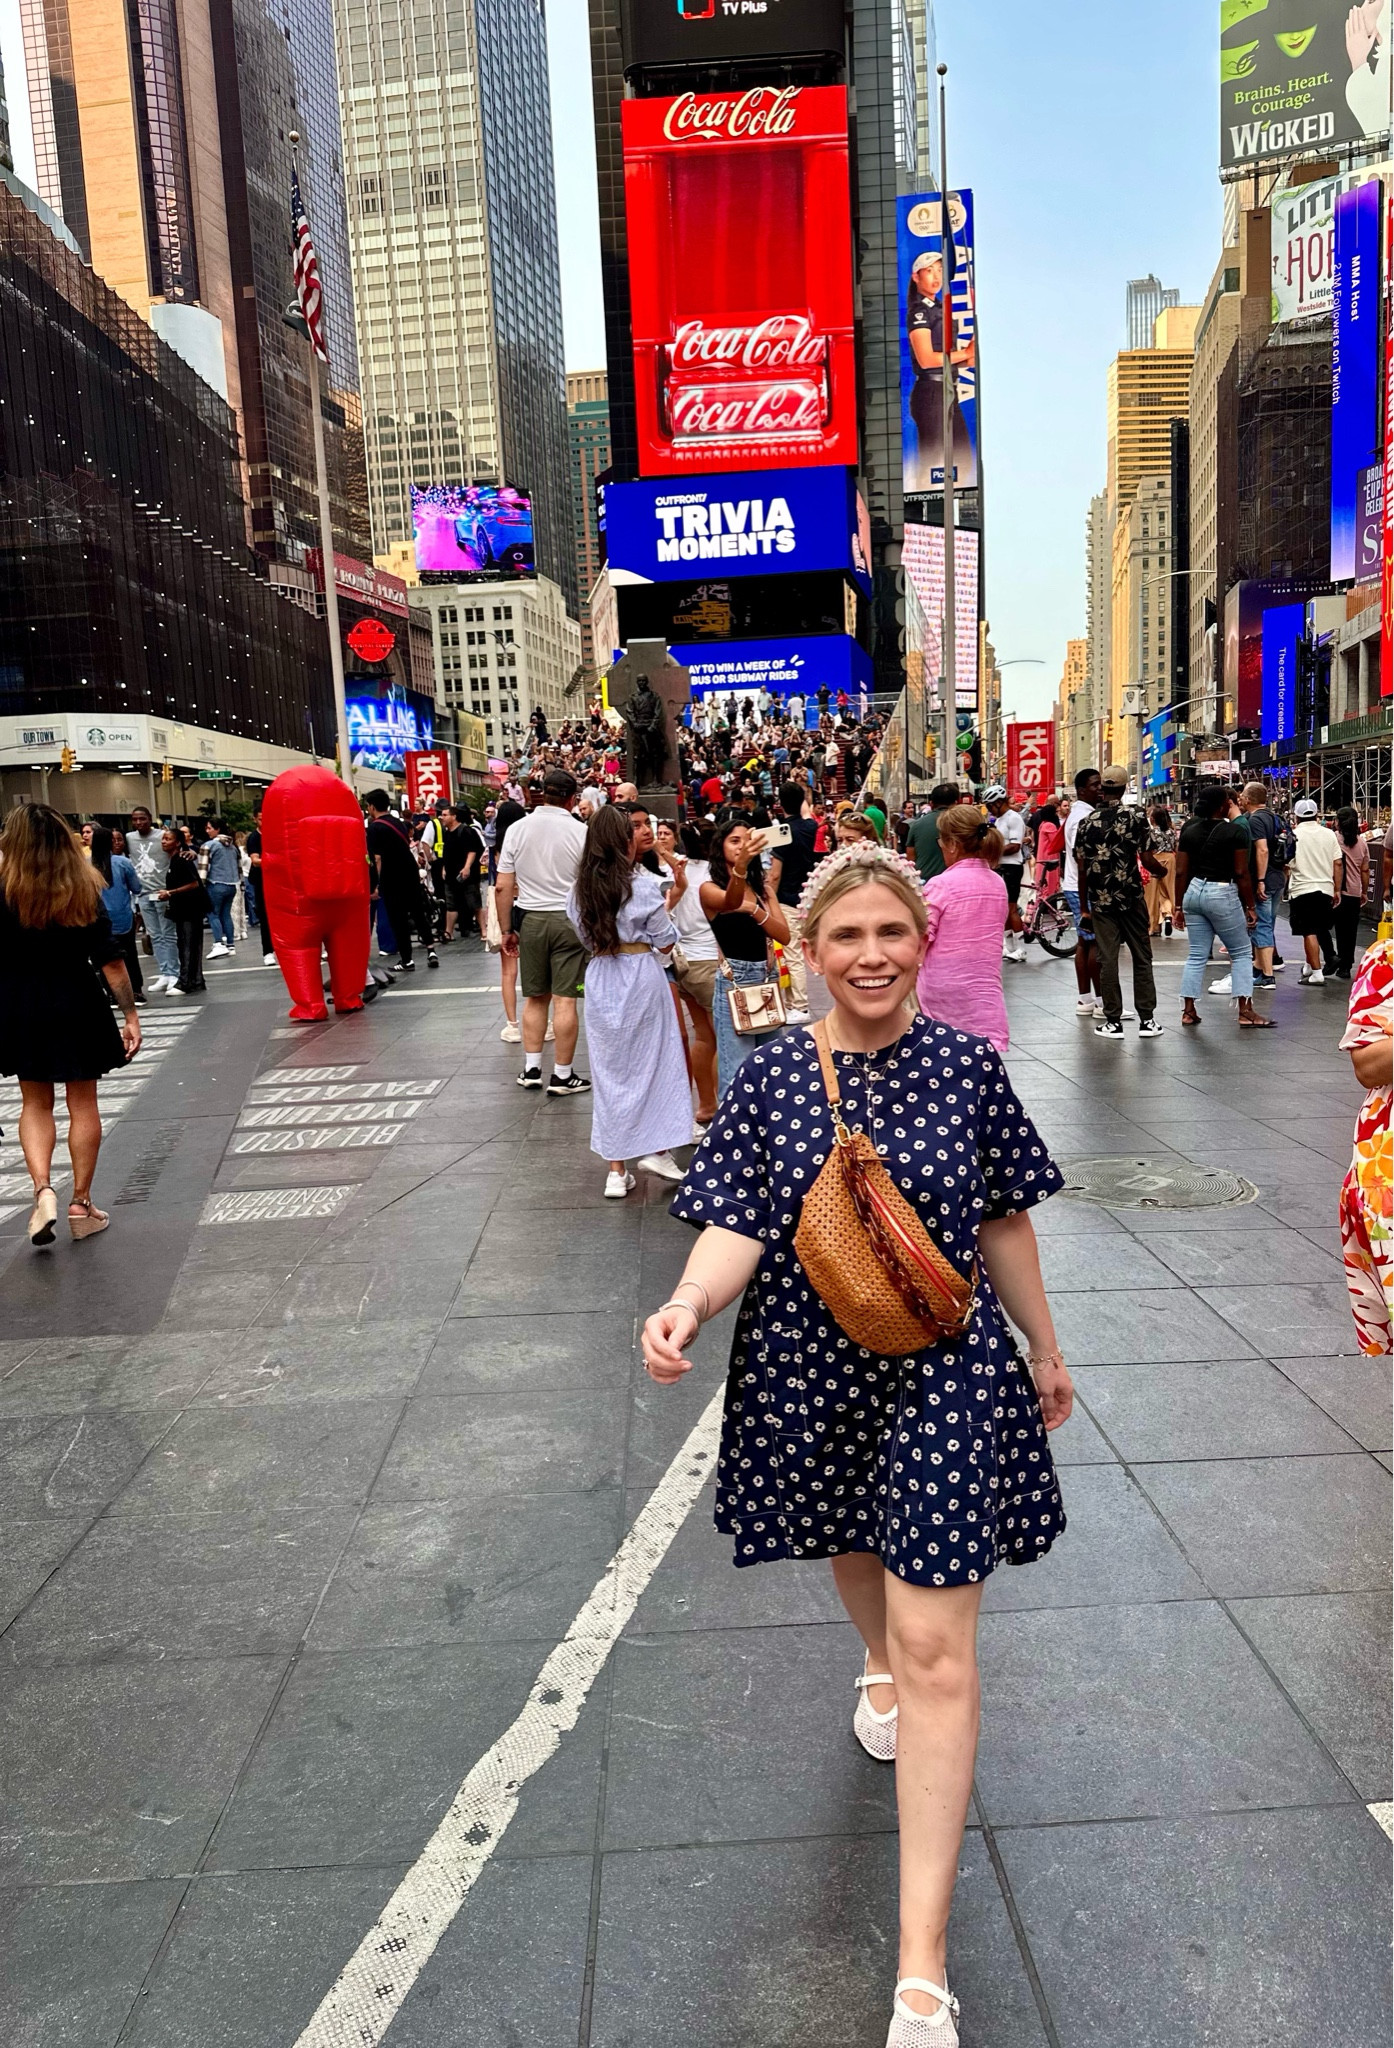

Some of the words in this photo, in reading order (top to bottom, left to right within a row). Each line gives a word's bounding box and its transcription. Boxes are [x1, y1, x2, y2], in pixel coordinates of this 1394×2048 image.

[721, 2, 739, 15] TV
[741, 1, 768, 14] Plus
[1234, 86, 1285, 105] Brains.
[1287, 71, 1333, 93] Heart.
[662, 85, 803, 141] Coca-Cola
[1251, 93, 1315, 115] Courage.
[1352, 254, 1361, 288] MMA
[1351, 290, 1361, 321] Host
[1332, 291, 1342, 346] Followers
[1332, 350, 1340, 364] on
[1332, 366, 1341, 405] Twitch
[655, 498, 796, 539] TRIVIA
[656, 529, 796, 562] MOMENTS
[702, 663, 715, 674] TO
[716, 662, 734, 673] WIN
[735, 662, 744, 671] A
[744, 660, 771, 671] WEEK
[772, 659, 786, 669] OF
[1278, 647, 1286, 665] The
[690, 675, 711, 686] BUS
[712, 674, 727, 684] OR
[727, 672, 768, 683] SUBWAY
[769, 670, 799, 681] RIDES
[1278, 666, 1286, 687] card
[1278, 688, 1286, 700] for
[1277, 702, 1285, 740] creators
[23, 732, 36, 744] OUR
[36, 731, 55, 743] TOWN
[108, 733, 132, 742] OPEN
[1019, 726, 1048, 788] tkts
[259, 1066, 358, 1084] CORT
[251, 1079, 442, 1104] PALACE
[243, 1100, 424, 1126] LYCEUM
[234, 1124, 404, 1153] BELASCO
[214, 1185, 351, 1210] SONDHEIM
[209, 1201, 338, 1222] STEPHEN
